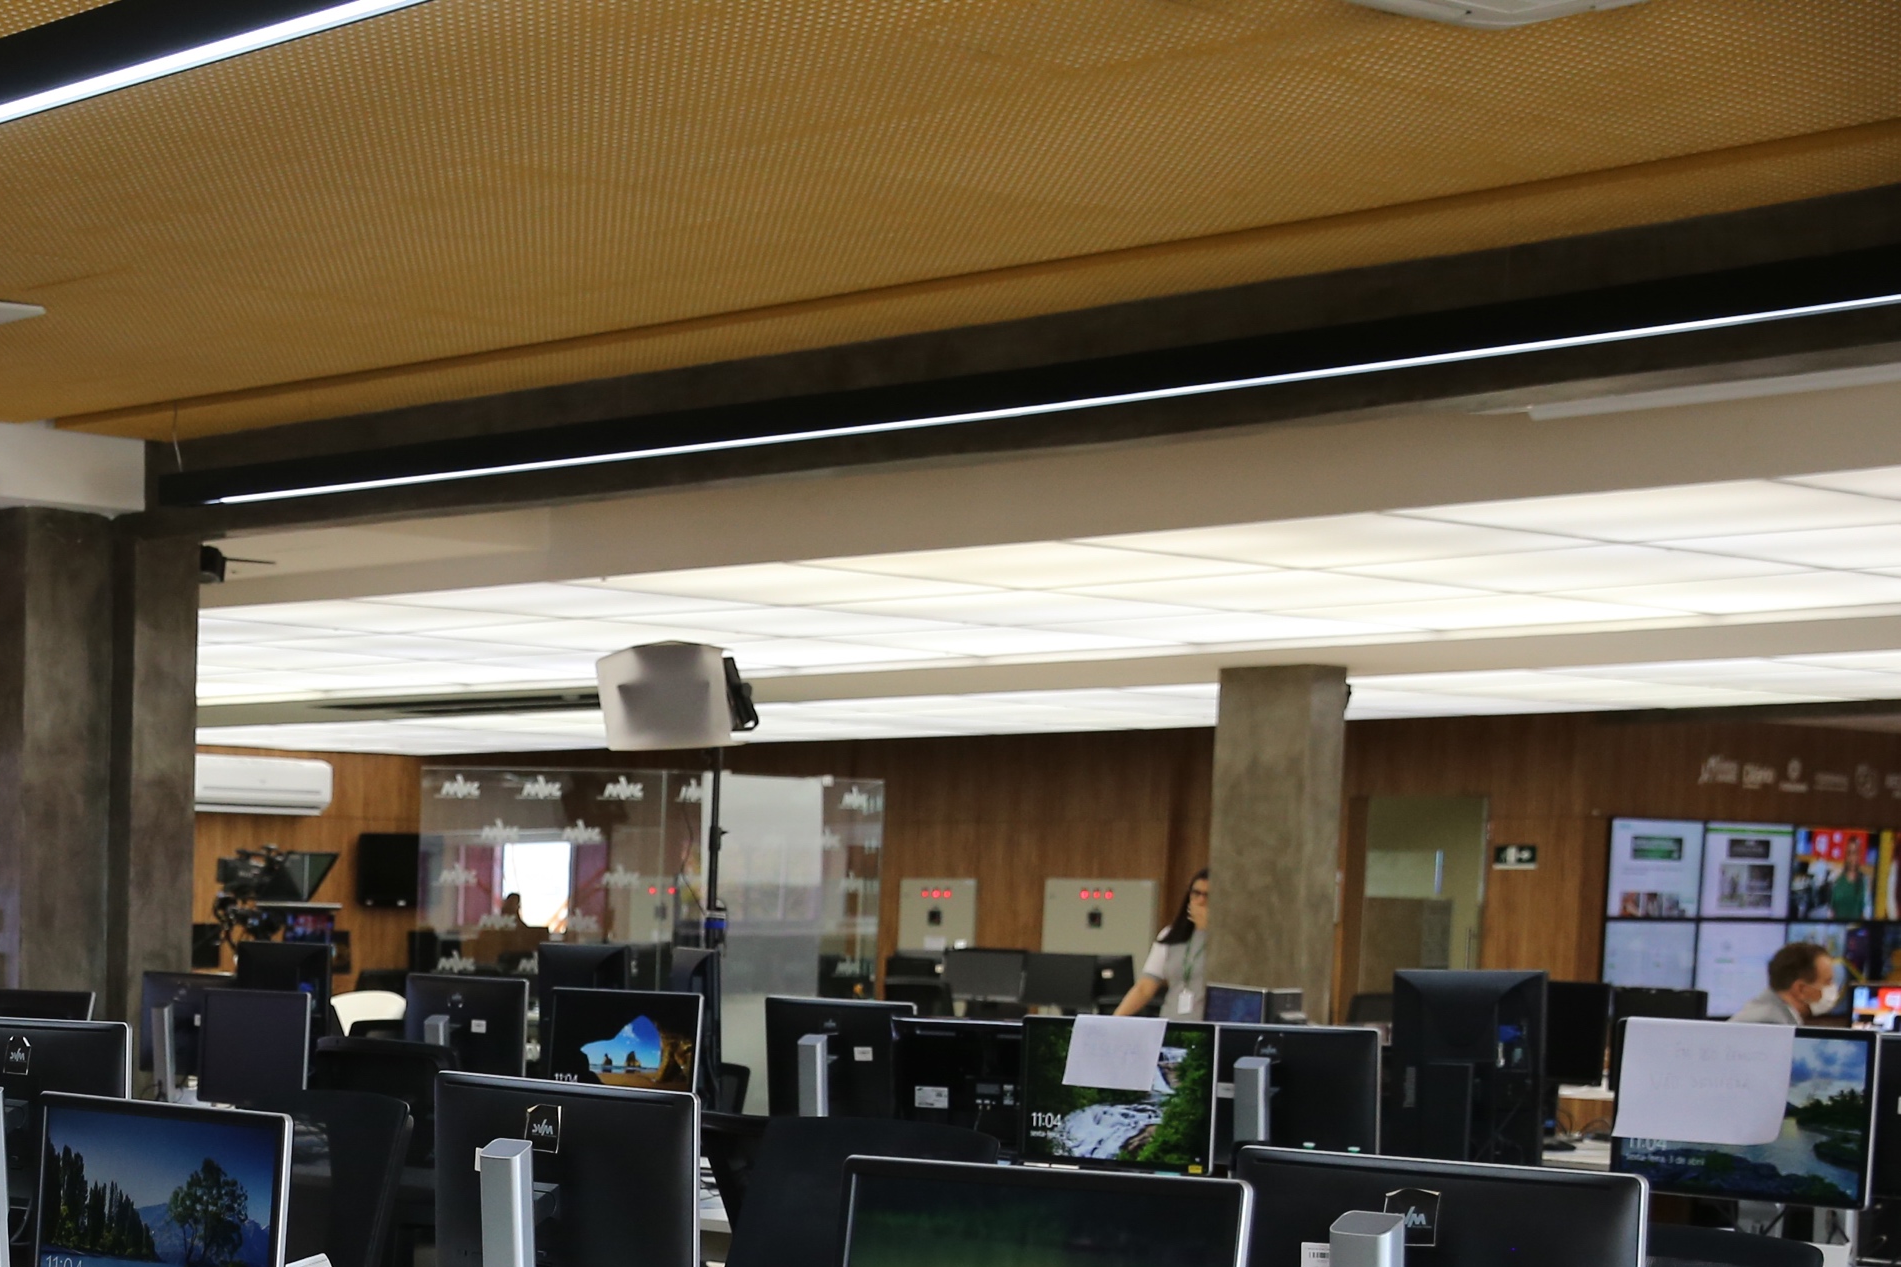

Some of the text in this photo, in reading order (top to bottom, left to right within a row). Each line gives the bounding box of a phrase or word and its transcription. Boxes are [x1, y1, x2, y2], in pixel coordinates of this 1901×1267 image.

[532, 1119, 554, 1136] SVM
[1031, 1112, 1061, 1128] 11:04
[1404, 1206, 1427, 1227] VM
